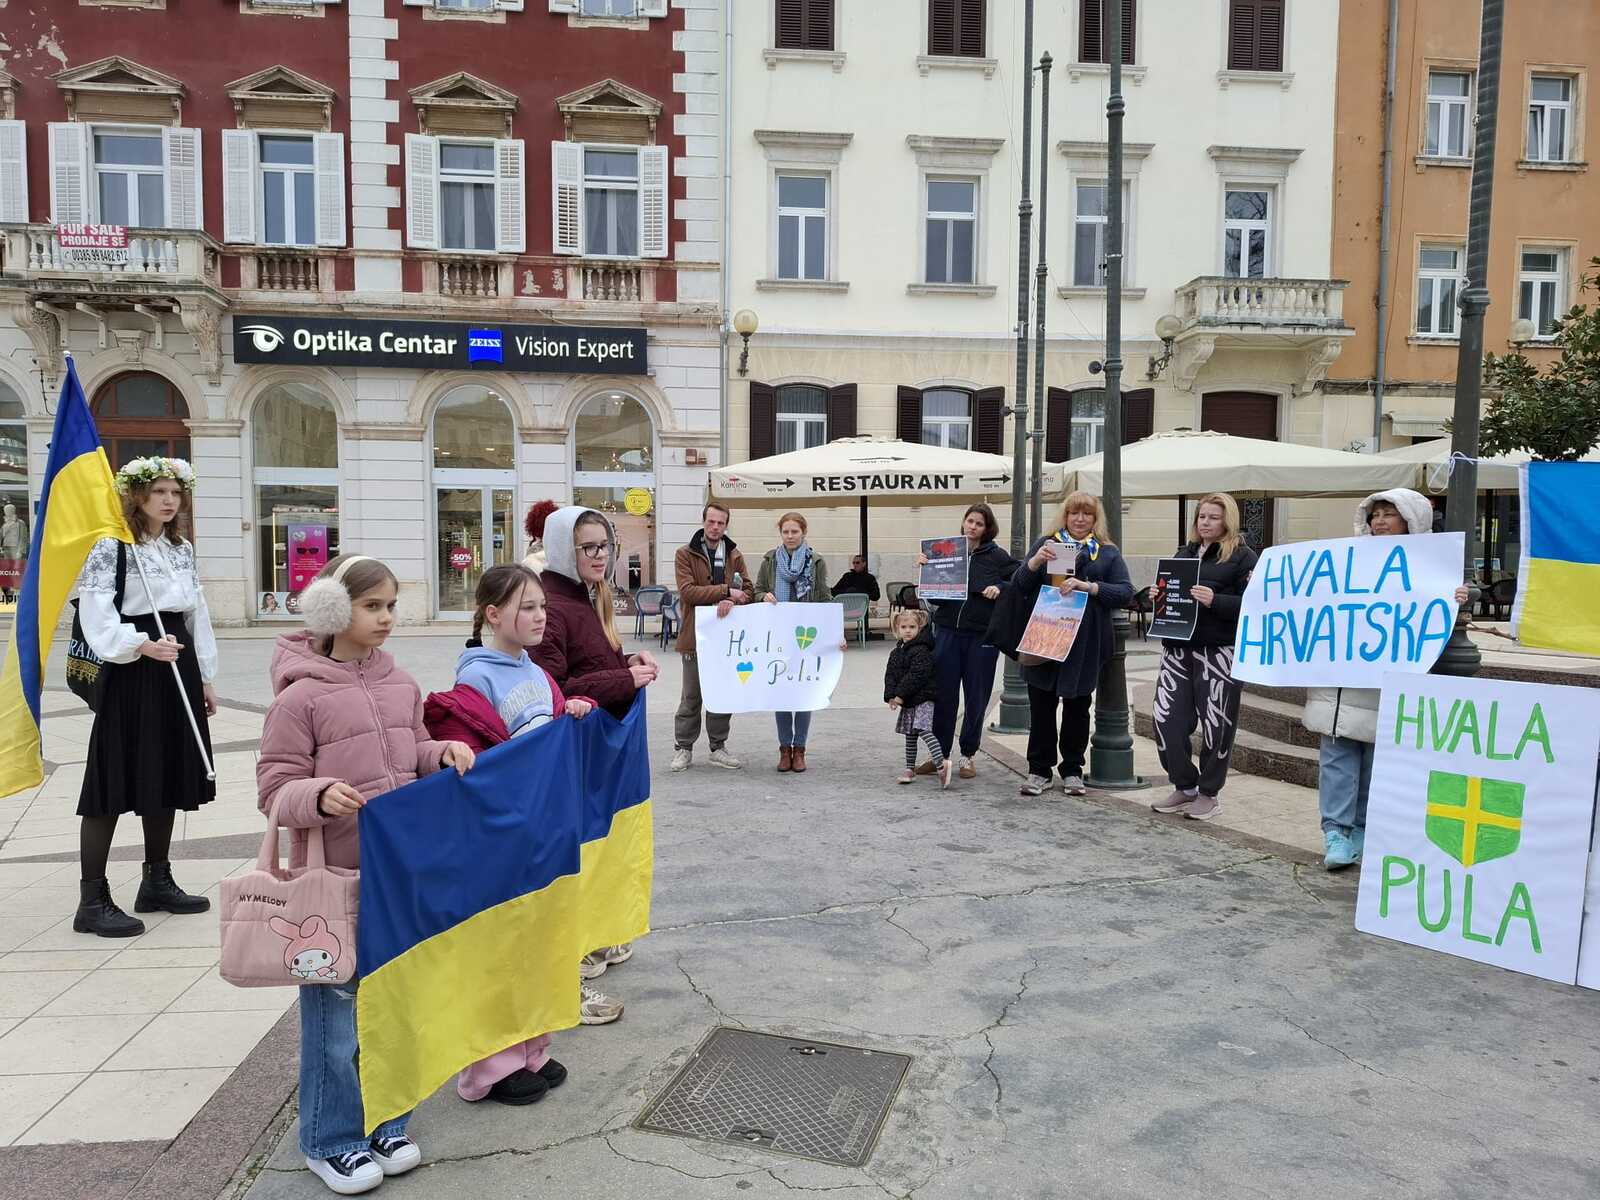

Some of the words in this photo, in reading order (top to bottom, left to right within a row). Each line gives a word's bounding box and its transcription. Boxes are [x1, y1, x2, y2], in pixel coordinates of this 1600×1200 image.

[61, 236, 109, 246] PRODAJE
[112, 236, 125, 247] SE
[90, 224, 125, 236] SALE
[293, 329, 372, 355] Optika
[379, 331, 458, 355] Centar
[469, 337, 501, 347] ZEISS
[515, 335, 569, 357] Vision
[577, 338, 633, 362] Expert
[812, 474, 964, 492] RESTAURANT
[451, 553, 471, 561] -50%
[1264, 545, 1412, 602] HVALA
[726, 629, 782, 656] Hvala
[1239, 598, 1452, 665] HRVATSKA
[767, 656, 821, 685] Pula!
[1394, 693, 1555, 763] HVALA
[240, 894, 252, 902] MY
[253, 894, 287, 908] MELODY
[1379, 855, 1542, 954] PULA
